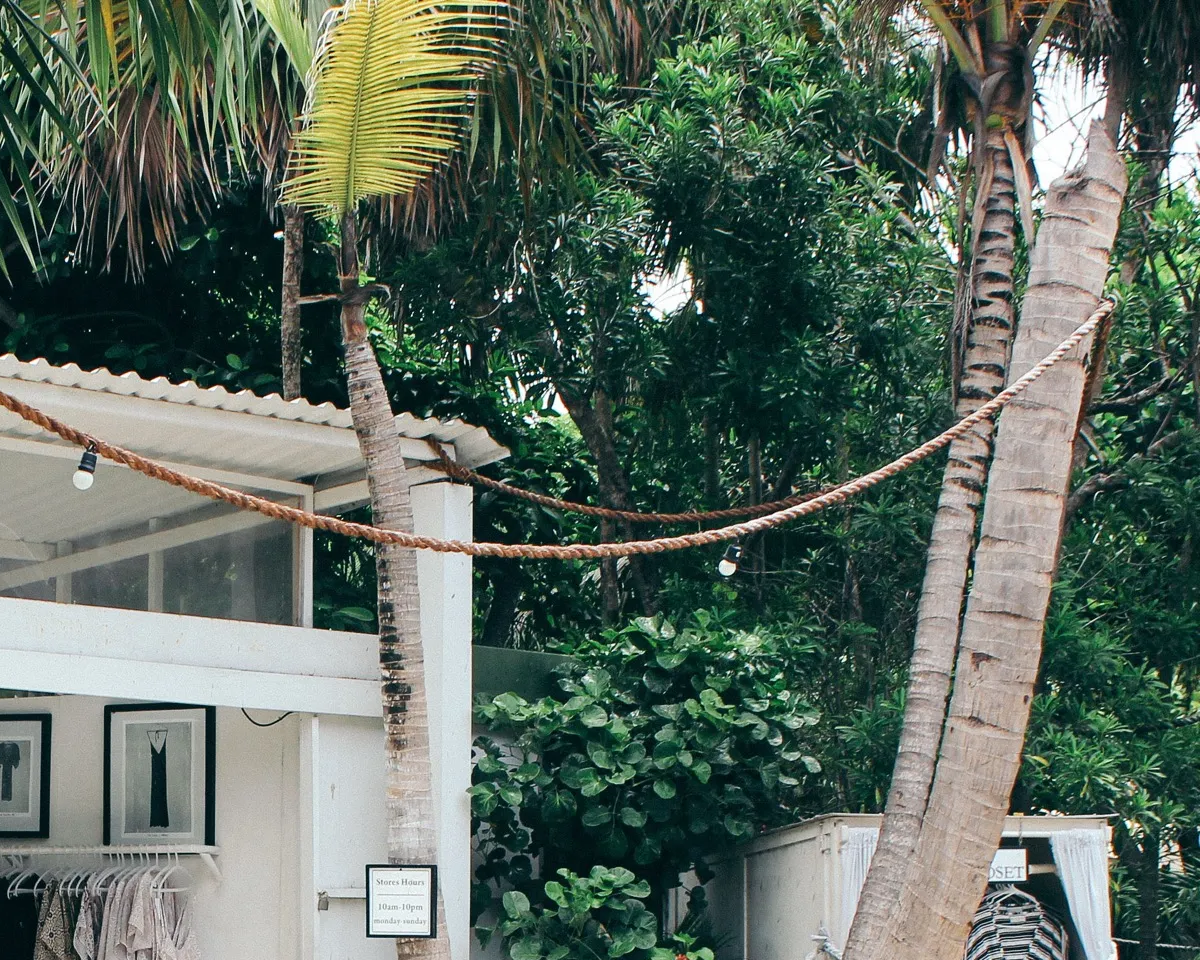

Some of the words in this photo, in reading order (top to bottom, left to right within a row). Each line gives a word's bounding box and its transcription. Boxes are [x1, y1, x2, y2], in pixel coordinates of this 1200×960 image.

[376, 878, 400, 886] Stores
[401, 878, 425, 886] Hours
[378, 903, 423, 913] 10am-10pm
[373, 917, 427, 926] monday-sunday
